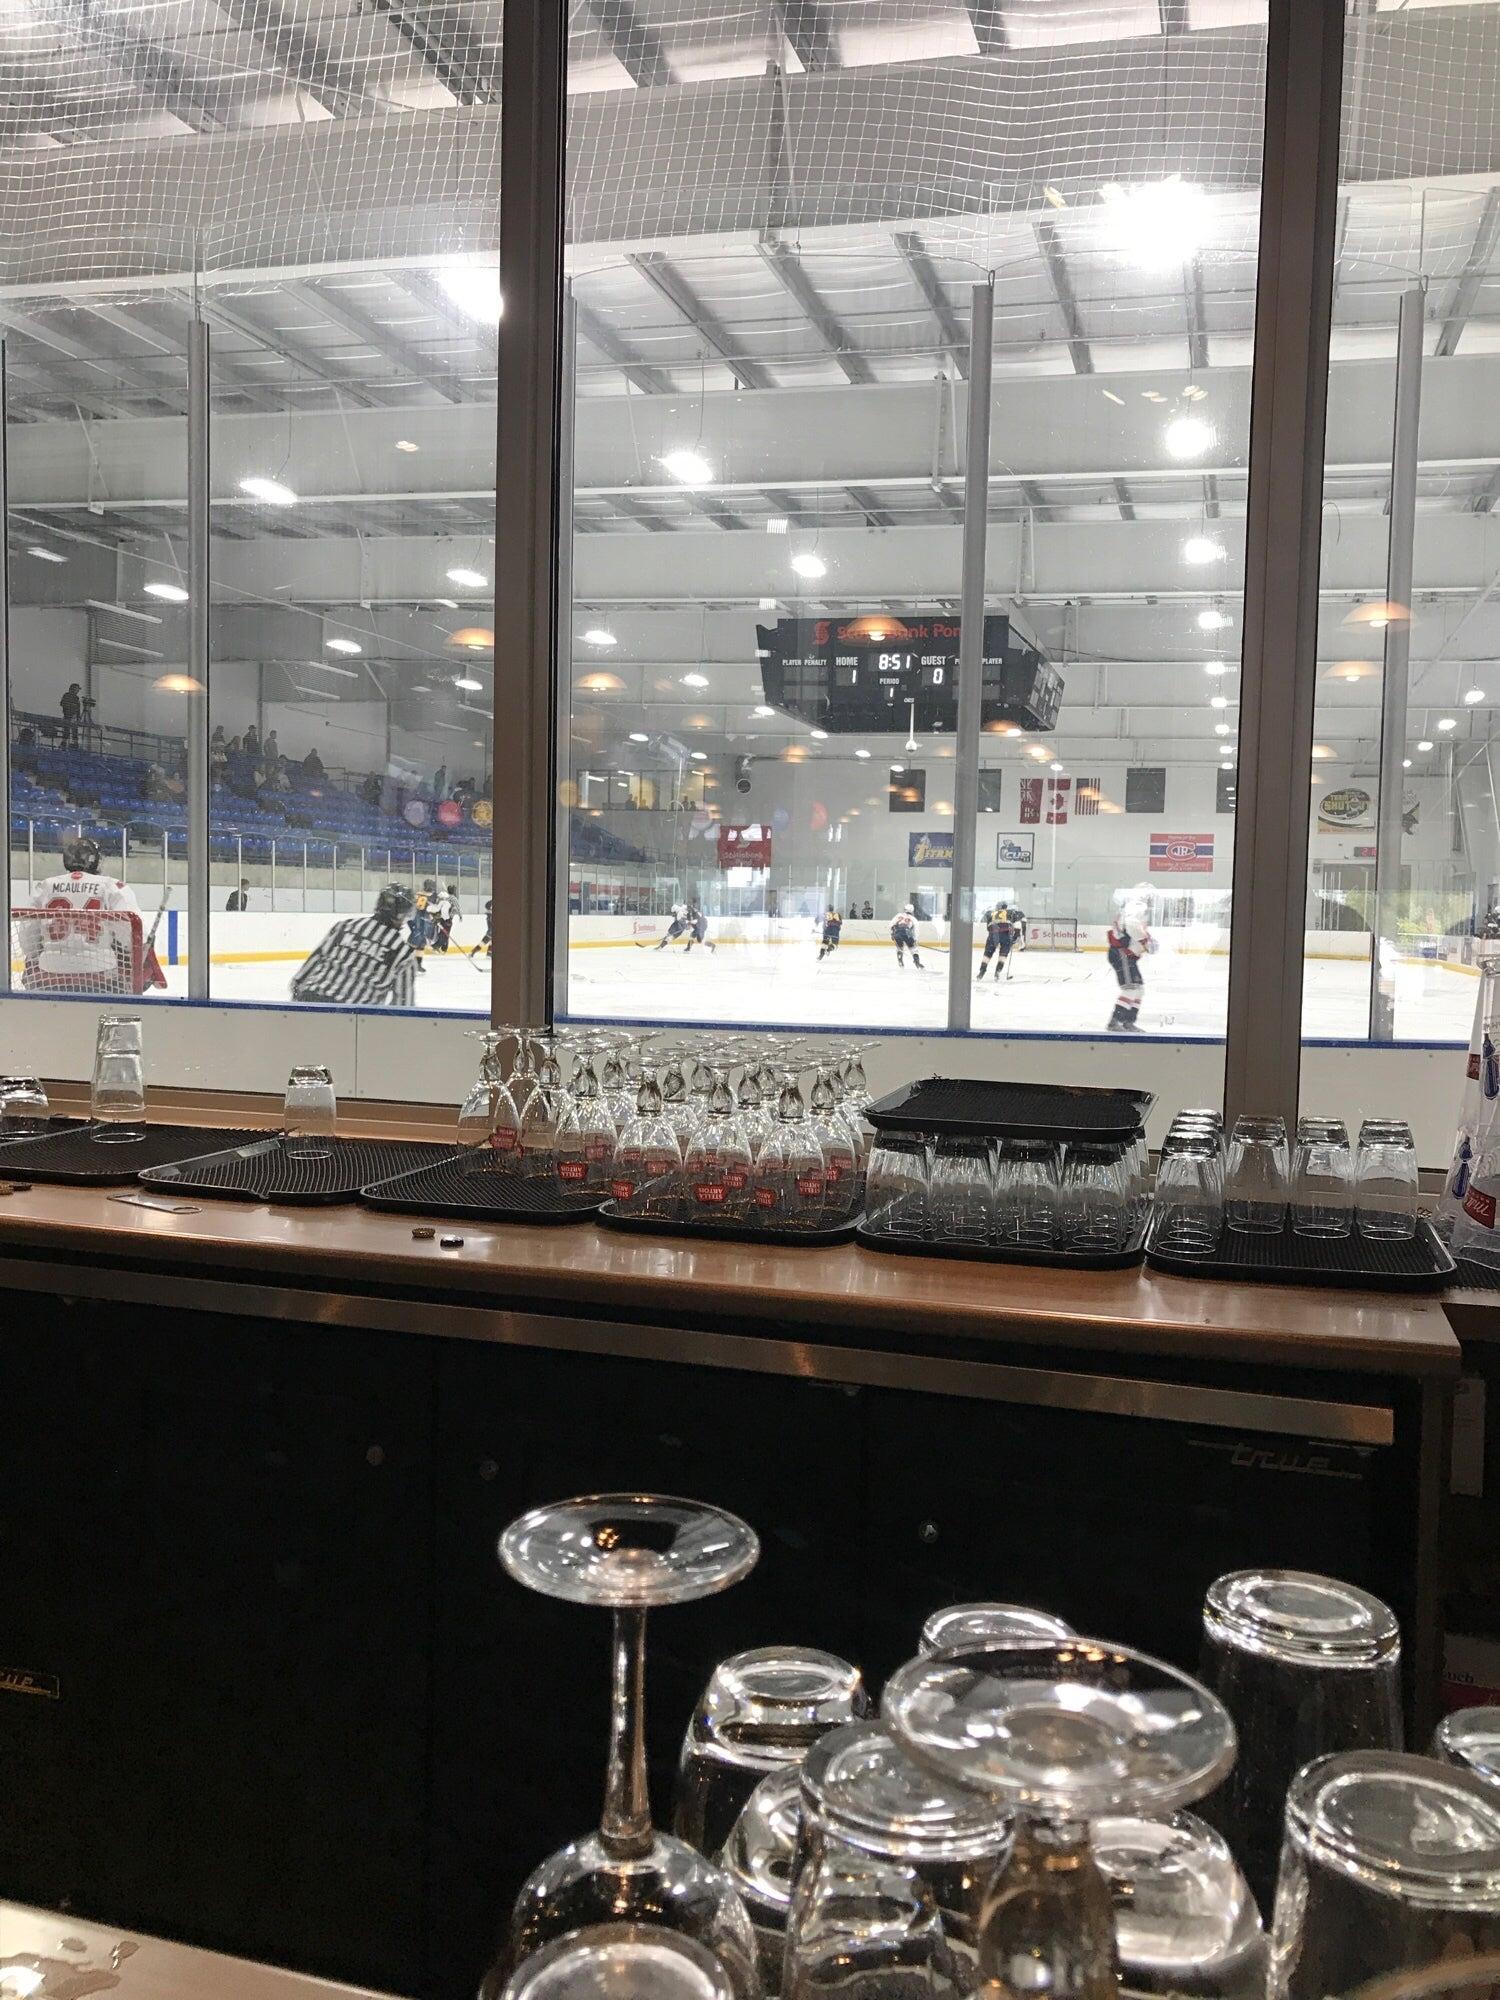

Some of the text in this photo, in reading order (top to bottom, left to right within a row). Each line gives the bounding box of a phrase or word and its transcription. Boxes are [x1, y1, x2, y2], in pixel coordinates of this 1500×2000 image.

[932, 622, 960, 637] Pon
[835, 656, 858, 666] HOME
[878, 654, 911, 670] 8:51
[920, 655, 946, 666] GUEST
[981, 657, 1003, 665] PLAYER
[851, 669, 858, 684] 1
[879, 677, 900, 685] PERIOD
[932, 667, 944, 684] 0
[888, 687, 895, 698] 1
[52, 882, 100, 895] MCAULIFFE
